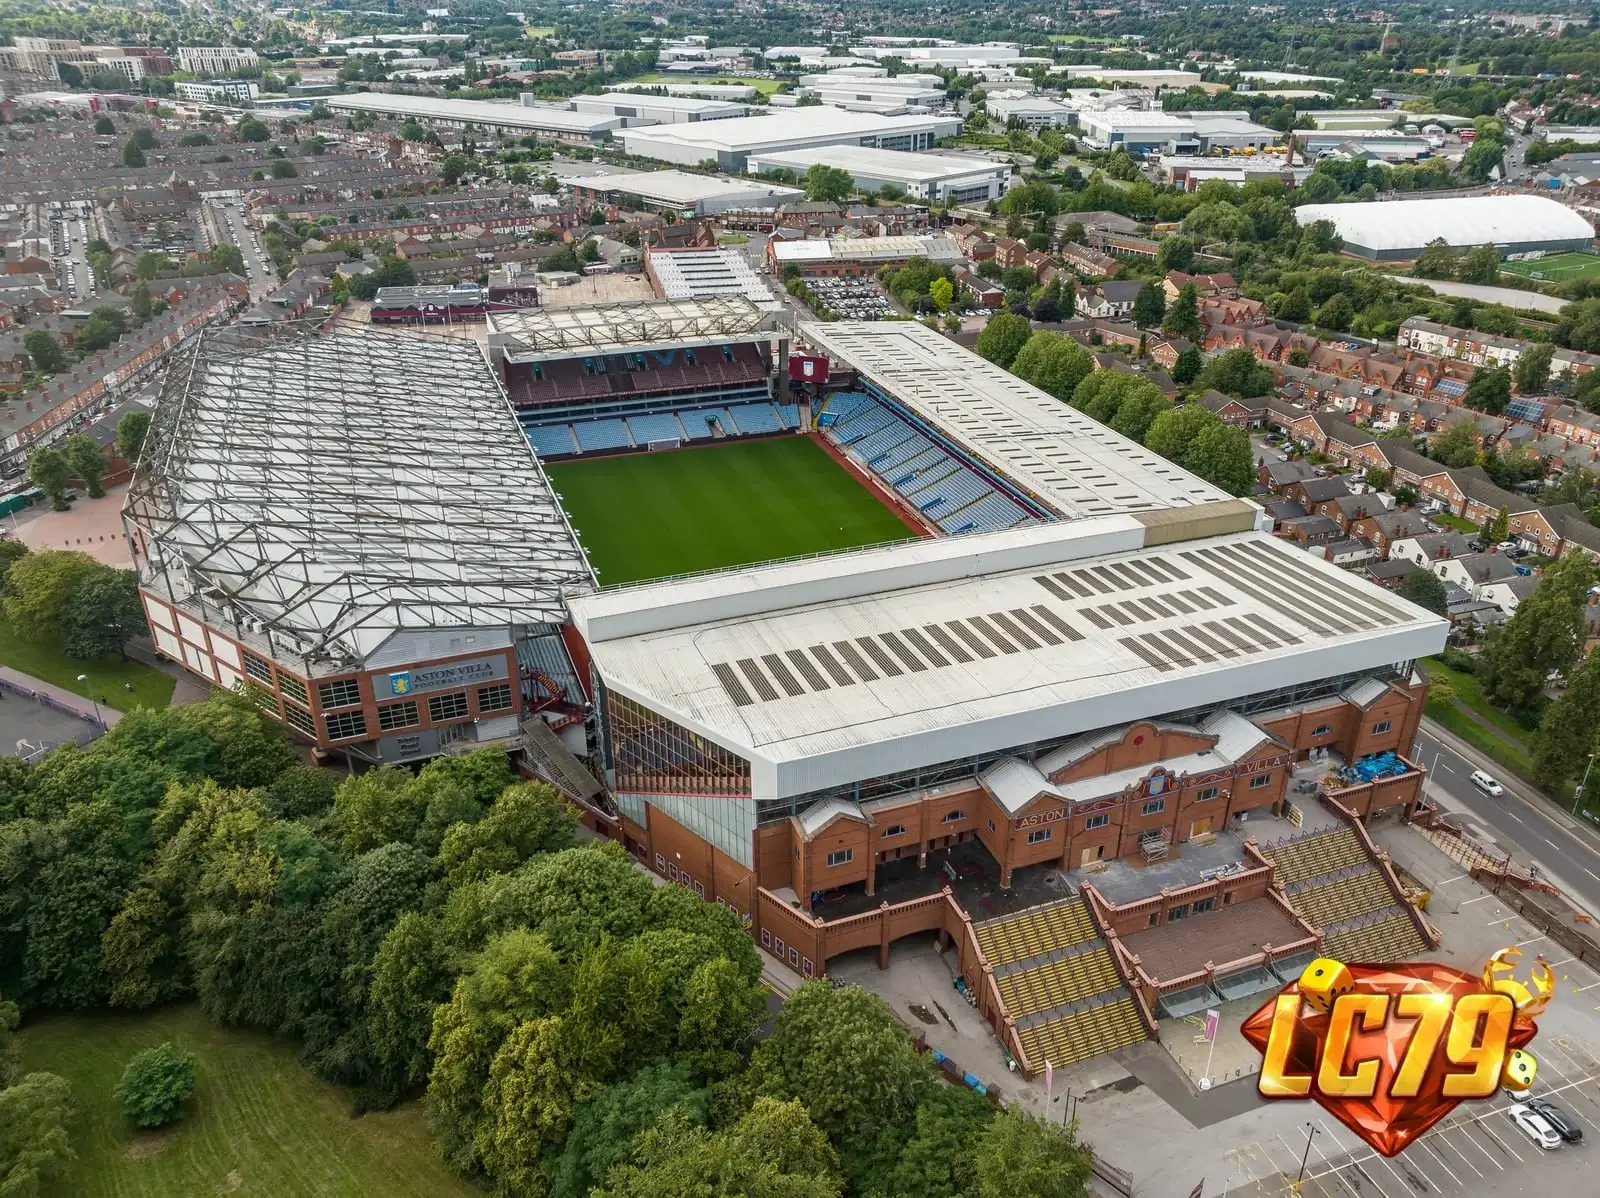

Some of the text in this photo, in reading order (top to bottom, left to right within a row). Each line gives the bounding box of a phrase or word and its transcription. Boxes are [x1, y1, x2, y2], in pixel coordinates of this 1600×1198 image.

[414, 662, 492, 683] ASTON VILLA
[414, 671, 494, 689] FOOTBALL CLUB
[1020, 757, 1281, 828] ASTON VILLA
